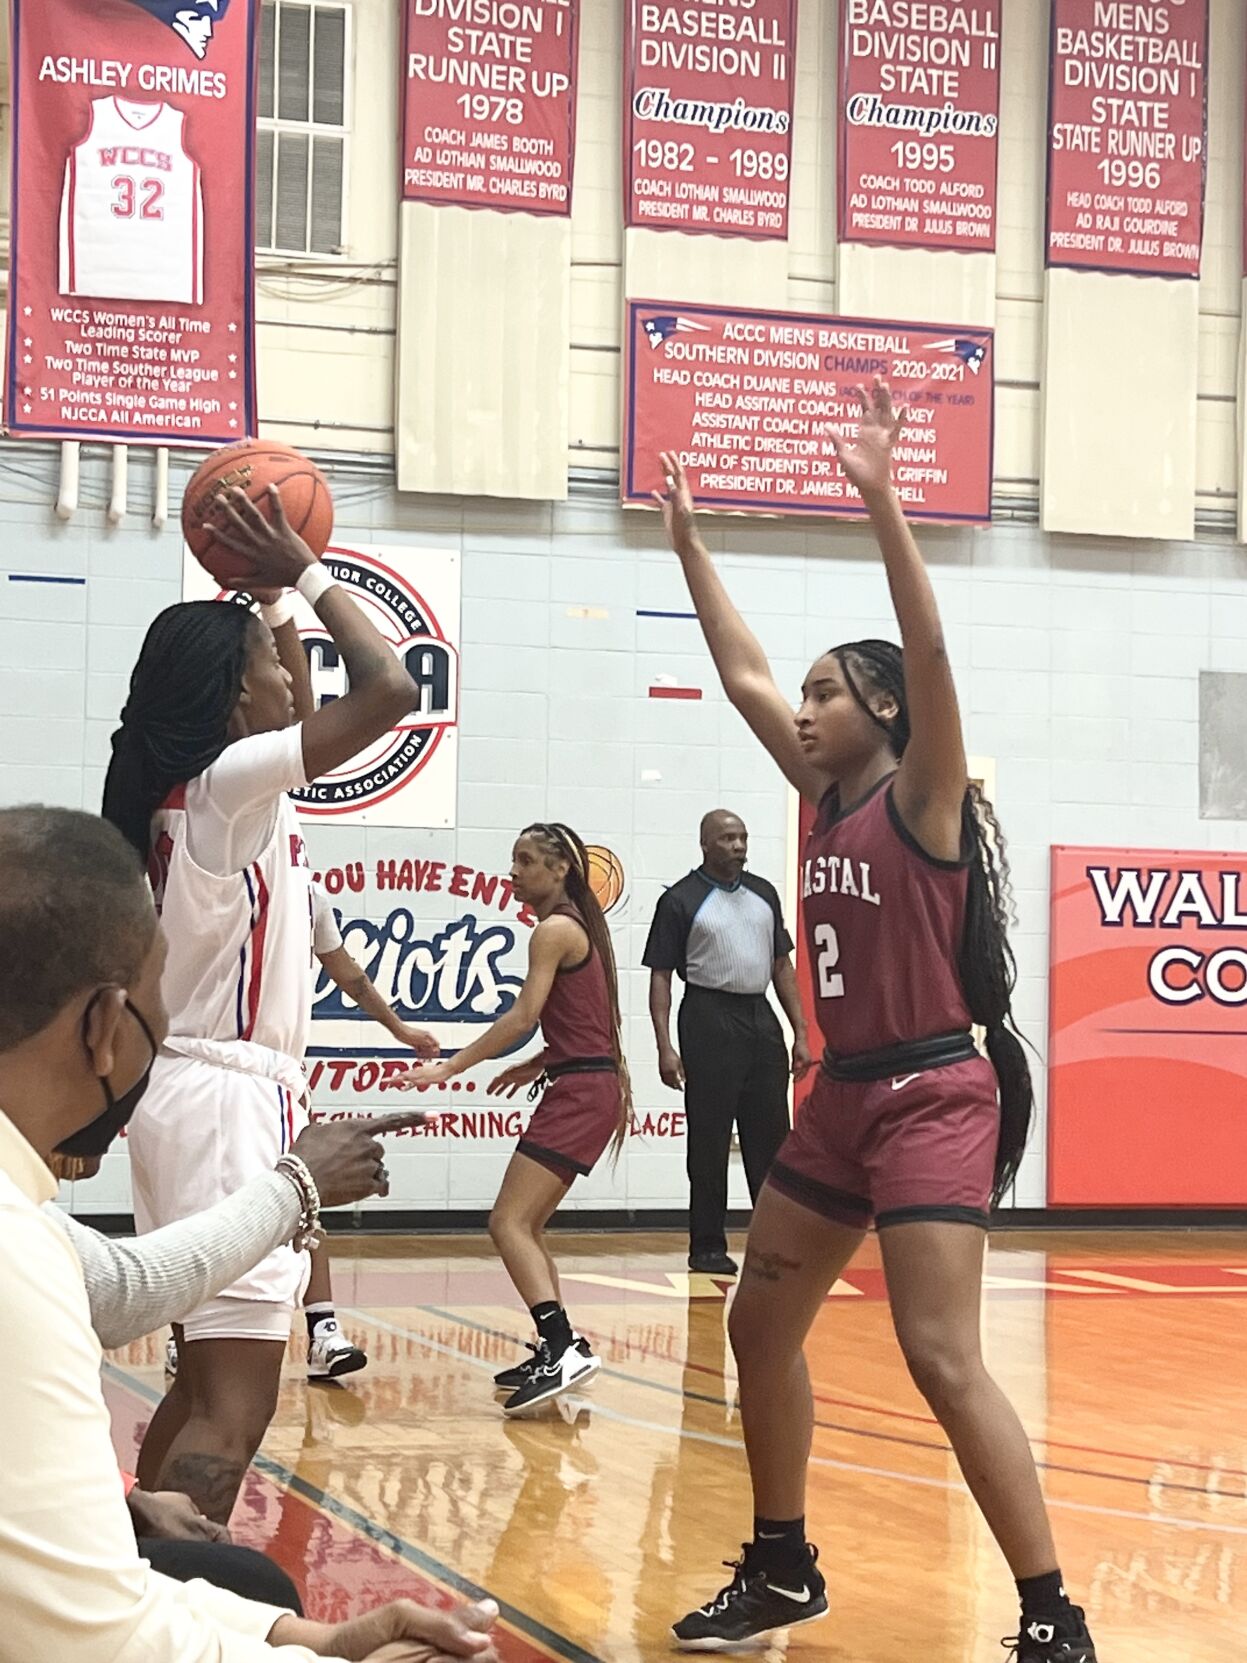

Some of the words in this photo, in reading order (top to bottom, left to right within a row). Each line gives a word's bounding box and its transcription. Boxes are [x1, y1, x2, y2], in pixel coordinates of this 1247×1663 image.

[415, 0, 543, 33] DIVISION
[556, 11, 563, 37] I
[641, 4, 786, 47] BASEBALL
[849, 0, 999, 39] BASEBALL
[1094, 1, 1170, 35] MENS
[447, 26, 533, 63] STATE
[640, 39, 761, 78] DIVISION
[772, 53, 786, 81] II
[852, 29, 971, 67] DIVISION
[983, 42, 996, 70] II
[1056, 27, 1202, 69] BASKETBALL
[39, 56, 132, 87] ASHLEY
[138, 65, 226, 98] GRIMES
[408, 52, 526, 94] RUNNER
[531, 70, 570, 98] UP
[879, 63, 960, 98] STATE
[1064, 59, 1180, 96] DIVISION
[1190, 72, 1196, 98] I
[456, 93, 524, 124] 1978
[633, 87, 790, 135] Champions
[846, 91, 999, 137] Champions
[1091, 96, 1169, 129] STATE
[424, 126, 466, 146] COACH
[470, 131, 509, 151] JAMES
[512, 136, 554, 156] BOOTH
[890, 141, 955, 173] 1995
[1052, 123, 1101, 153] STATE
[1107, 129, 1176, 160] RUNNER
[1182, 134, 1202, 163] UP
[98, 147, 172, 171] WCCS
[414, 147, 433, 164] AD
[489, 154, 562, 178] SMALLWOOD
[633, 139, 694, 172] 1982
[729, 148, 789, 182] 1989
[1097, 159, 1161, 189] 1996
[111, 175, 164, 220] 32
[405, 168, 465, 189] PRESIDENT
[489, 177, 537, 198] CHARLES
[538, 183, 568, 202] BYRD
[634, 178, 672, 197] COACH
[722, 187, 787, 209] SMALLWOOD
[859, 174, 900, 192] COACH
[903, 178, 936, 194] TODD
[939, 181, 984, 198] ALFORD
[639, 200, 690, 220] PRESIDENT
[713, 207, 755, 227] CHARLES
[757, 212, 783, 229] BYRD
[850, 193, 867, 209] AD
[922, 201, 992, 219] SMALLWOOD
[1066, 192, 1092, 209] HEAD
[1094, 194, 1125, 211] COACH
[1127, 196, 1152, 214] TODD
[1154, 199, 1188, 217] ALFORD
[852, 212, 902, 230] PRESIDENT
[955, 221, 990, 238] BROWN
[1076, 212, 1092, 229] AD
[1095, 215, 1120, 232] RAJI
[1050, 231, 1106, 251] PRESIDENT
[1163, 242, 1199, 260] BROWN
[50, 308, 89, 323] WCCS
[94, 311, 155, 329] Women's
[159, 316, 175, 330] All
[178, 318, 211, 333] Time
[81, 325, 134, 342] Leading
[139, 329, 182, 344] Scorer
[65, 340, 92, 355] Two
[96, 342, 127, 358] Time
[132, 345, 167, 361] State
[170, 349, 200, 364] MVP
[722, 322, 766, 343] ACCC
[769, 326, 815, 347] MENS
[818, 330, 910, 354] BASKETBALL
[45, 356, 72, 370] Two
[76, 359, 109, 373] Time
[112, 361, 167, 377] Souther
[170, 364, 219, 383] League
[664, 341, 749, 365] SOUTHERN
[753, 348, 819, 371] DIVISION
[824, 355, 889, 375] CHAMPS
[892, 359, 965, 382] 2020-2021
[72, 372, 115, 389] Player
[118, 375, 133, 388] of
[136, 376, 159, 391] the
[162, 379, 192, 393] Year
[653, 368, 691, 385] HEAD
[693, 371, 740, 390] COACH
[743, 375, 791, 394] DUANE
[793, 380, 836, 397] EVANS
[40, 387, 55, 400] 51
[59, 389, 102, 405] Points
[105, 392, 145, 410] Single
[148, 397, 186, 411] Game
[189, 399, 220, 414] High
[695, 392, 732, 408] HEAD
[735, 394, 796, 414] ASSITANT
[798, 400, 843, 417] COACH
[61, 406, 107, 422] NJCCA
[111, 409, 129, 424] All
[132, 411, 201, 428] American
[692, 411, 760, 432] ASSISTANT
[763, 418, 808, 435] COACH
[691, 432, 751, 450] ATHLETIC
[754, 437, 818, 455] DIRECTOR
[679, 451, 717, 468] DEAN
[720, 454, 739, 469] OF
[741, 457, 809, 475] STUDENTS
[811, 461, 834, 476] DR.
[897, 467, 948, 484] GRIFFIN
[700, 473, 773, 491] PRESIDENT
[775, 478, 797, 494] DR.
[800, 481, 843, 497] JAMES
[365, 577, 423, 631] COLLEGE
[334, 734, 423, 799] ASSOCIATION
[312, 861, 365, 895] OU
[376, 859, 446, 892] HAVE
[1086, 866, 1247, 930] WAL
[815, 923, 844, 998] 2
[1147, 945, 1247, 1006] CO
